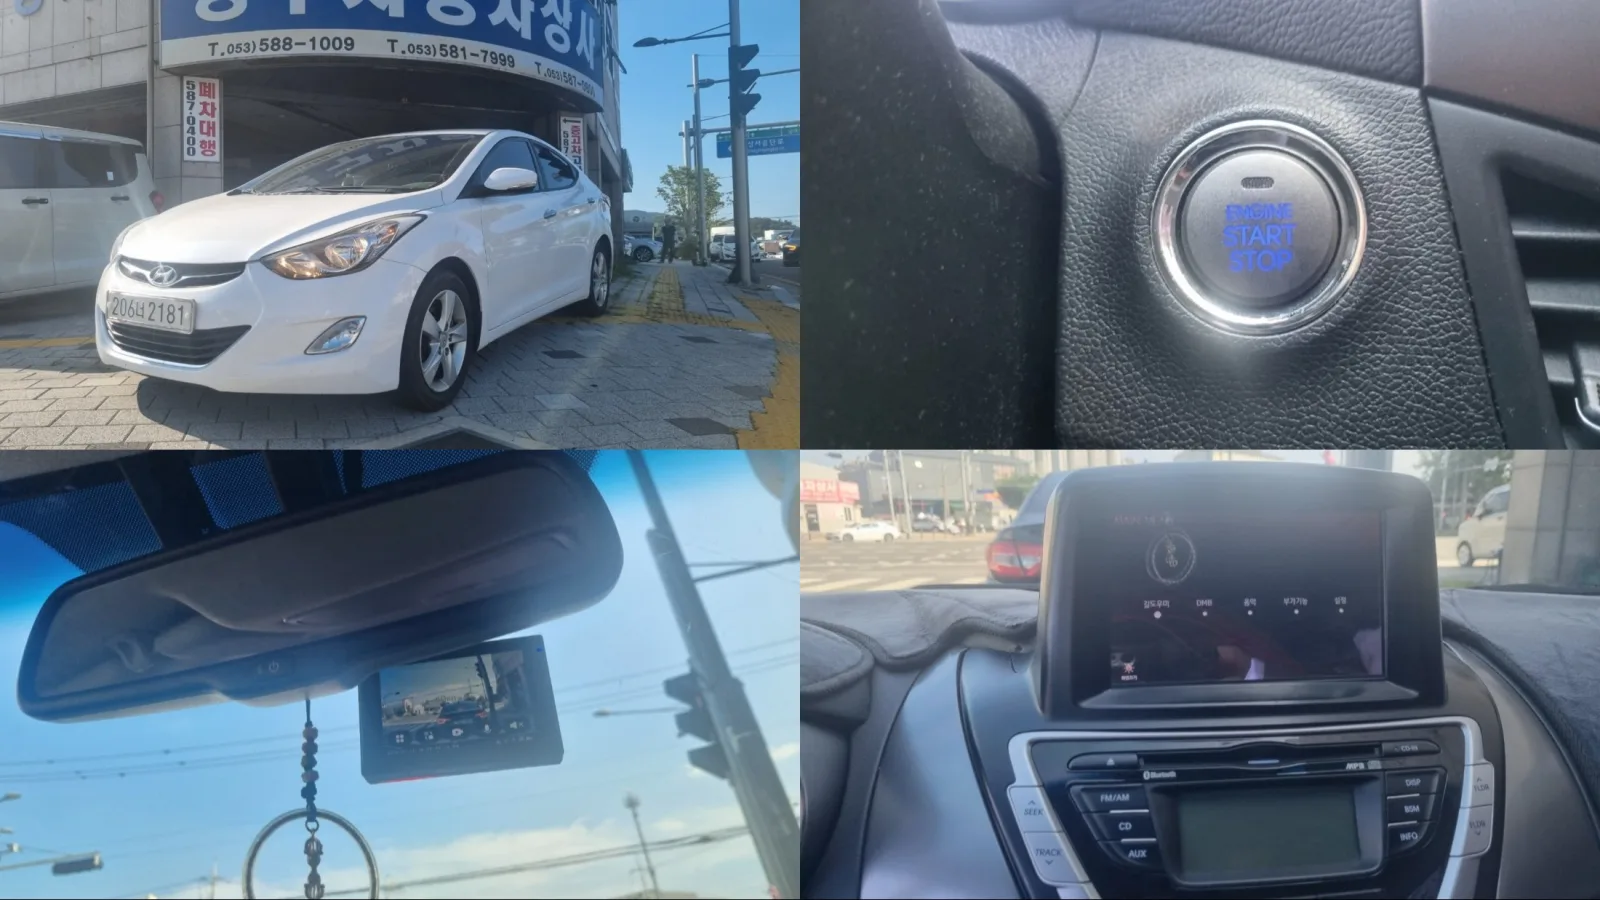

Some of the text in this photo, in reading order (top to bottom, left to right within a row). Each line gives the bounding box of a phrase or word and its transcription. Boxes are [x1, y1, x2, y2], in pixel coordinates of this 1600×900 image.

[199, 81, 217, 157] 폐차대행
[1225, 203, 1293, 221] ENGINE
[1223, 224, 1297, 248] START
[1229, 249, 1293, 272] STOP
[111, 296, 185, 326] 206너 2181
[1196, 599, 1213, 607] DMB
[1405, 779, 1421, 787] DISP
[1100, 793, 1130, 803] FM/AM
[1024, 808, 1044, 816] SEEK
[1404, 805, 1420, 813] BSM
[1118, 821, 1132, 831] CD
[1399, 831, 1419, 841] INFO
[1035, 848, 1061, 857] TRACK
[1128, 849, 1147, 858] AUX
